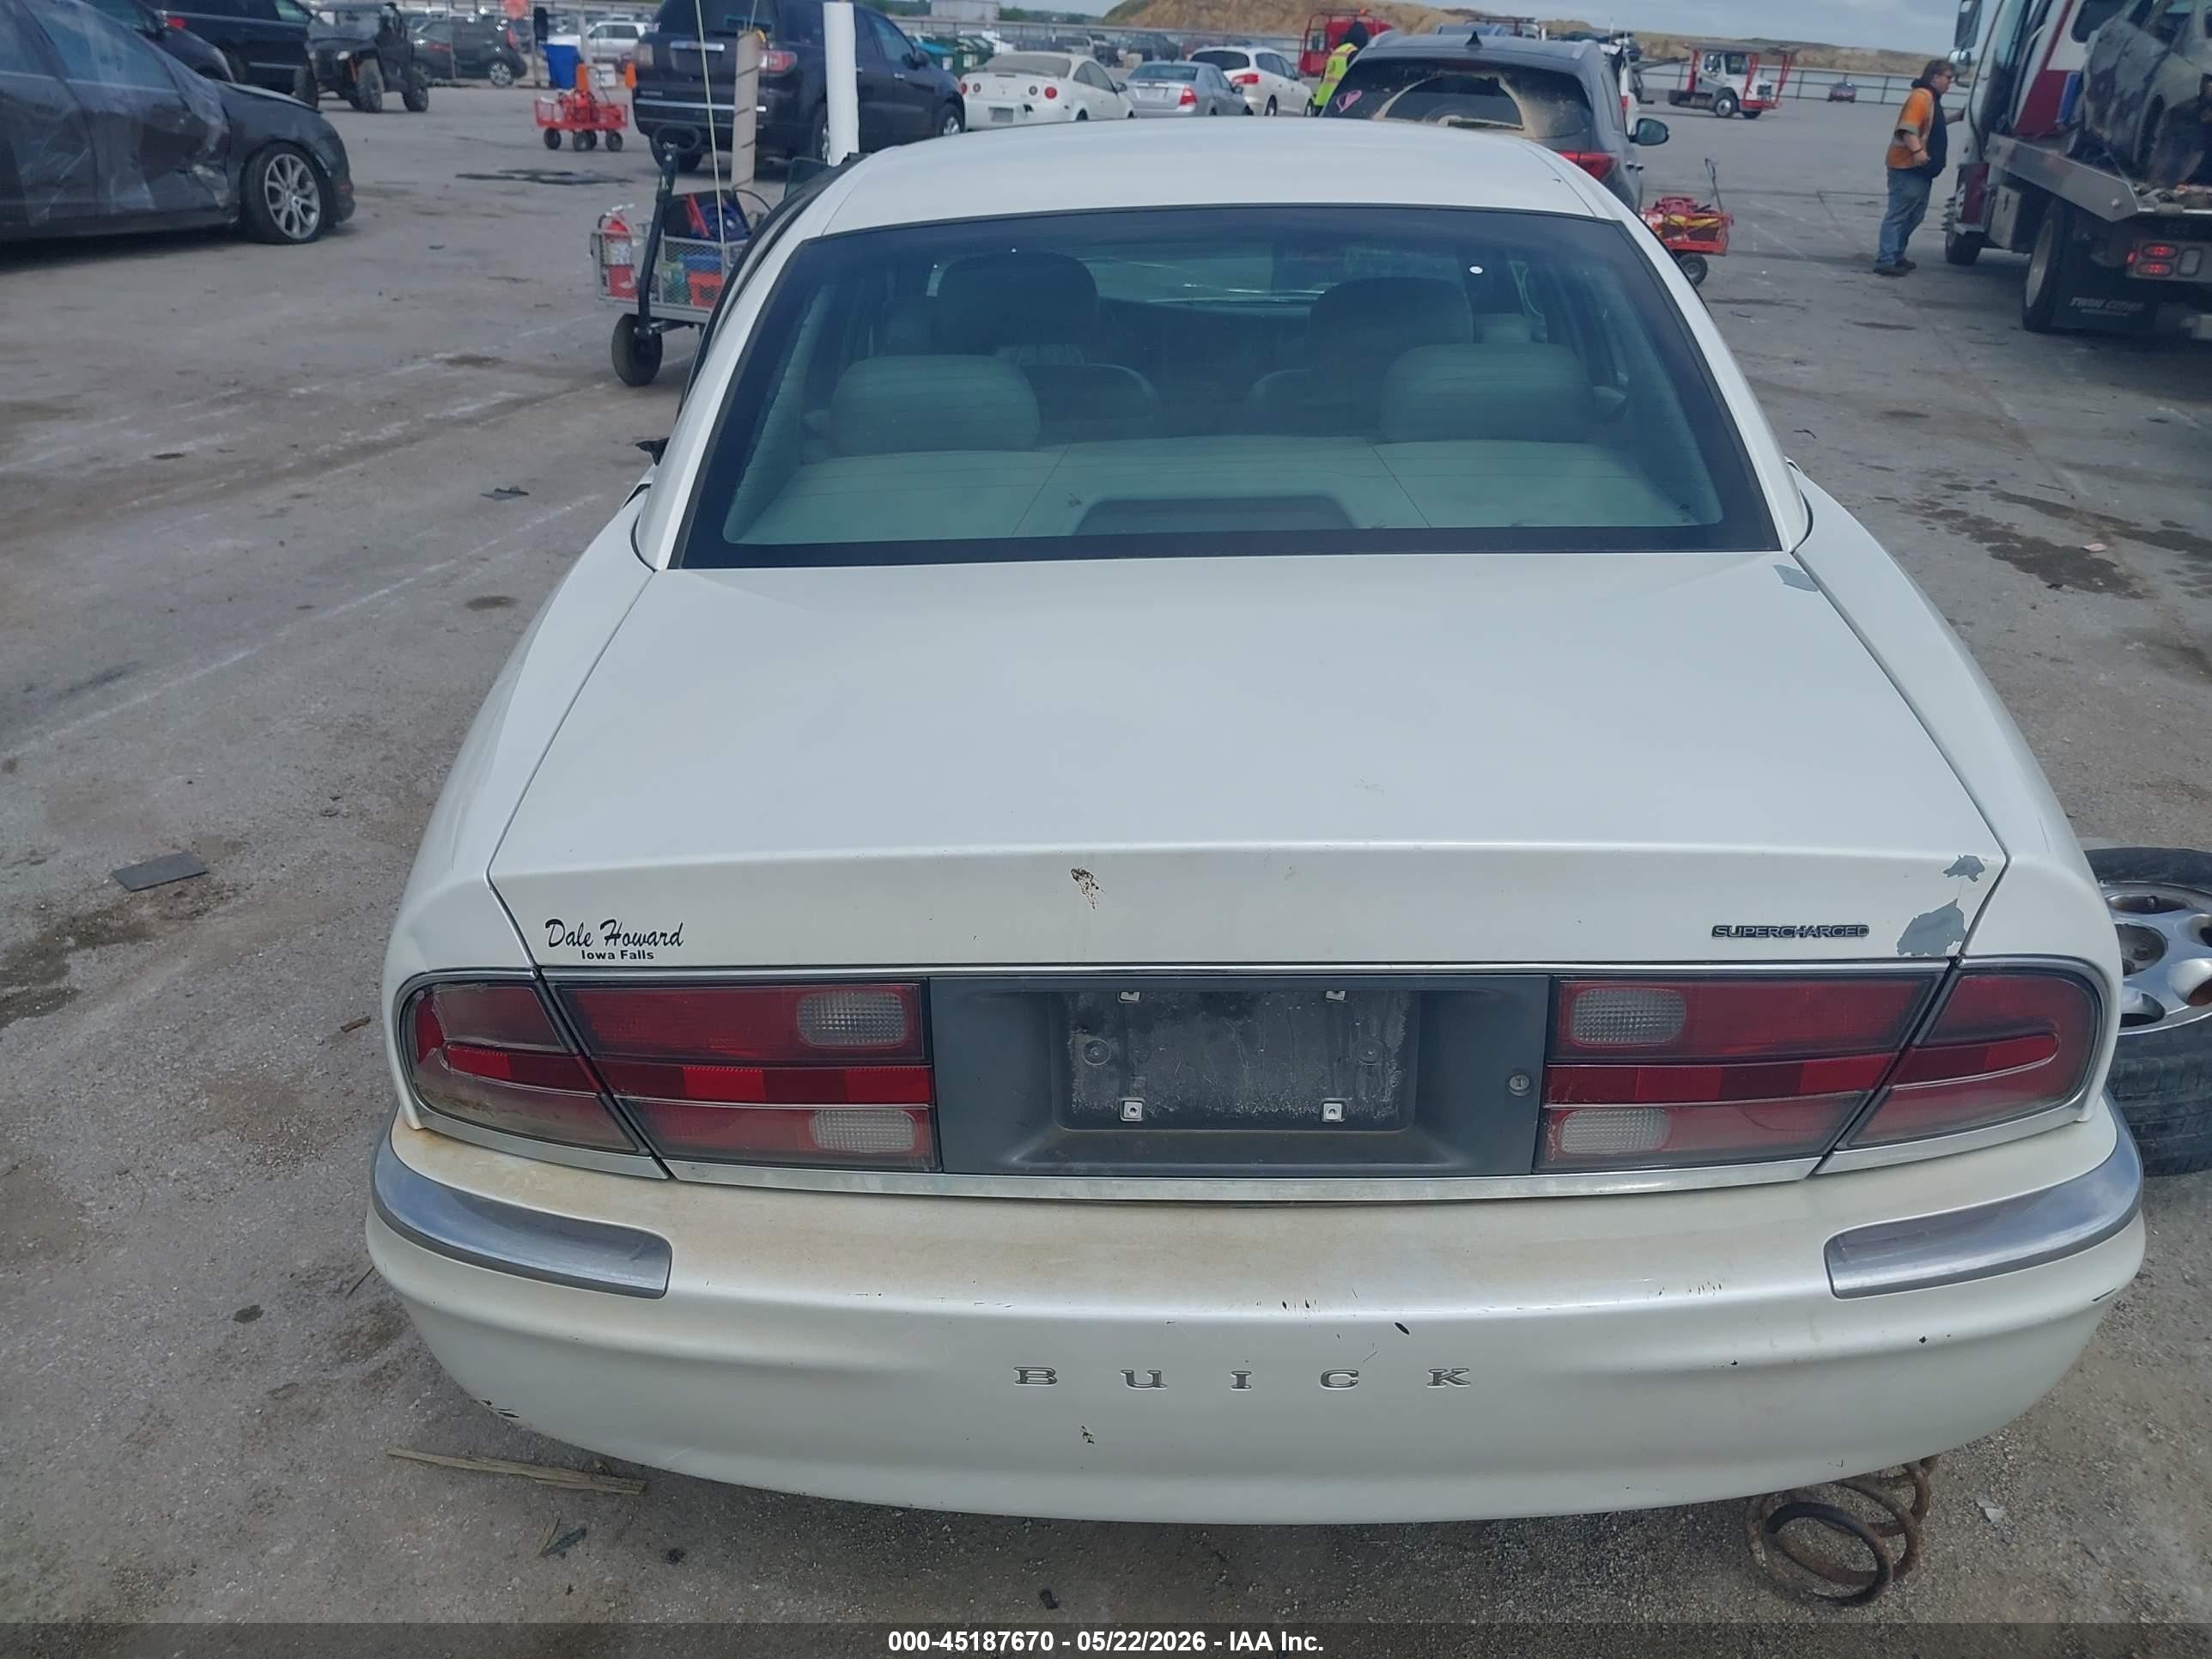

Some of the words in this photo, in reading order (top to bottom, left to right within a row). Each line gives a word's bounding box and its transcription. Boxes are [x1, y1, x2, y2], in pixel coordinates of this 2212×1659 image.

[545, 918, 593, 947] Dale
[600, 919, 684, 947] Howard
[1711, 925, 1869, 938] SUPERCHARGED
[581, 949, 616, 960] Iowa
[620, 949, 654, 960] Falls
[1015, 1366, 1470, 1389] BUICK
